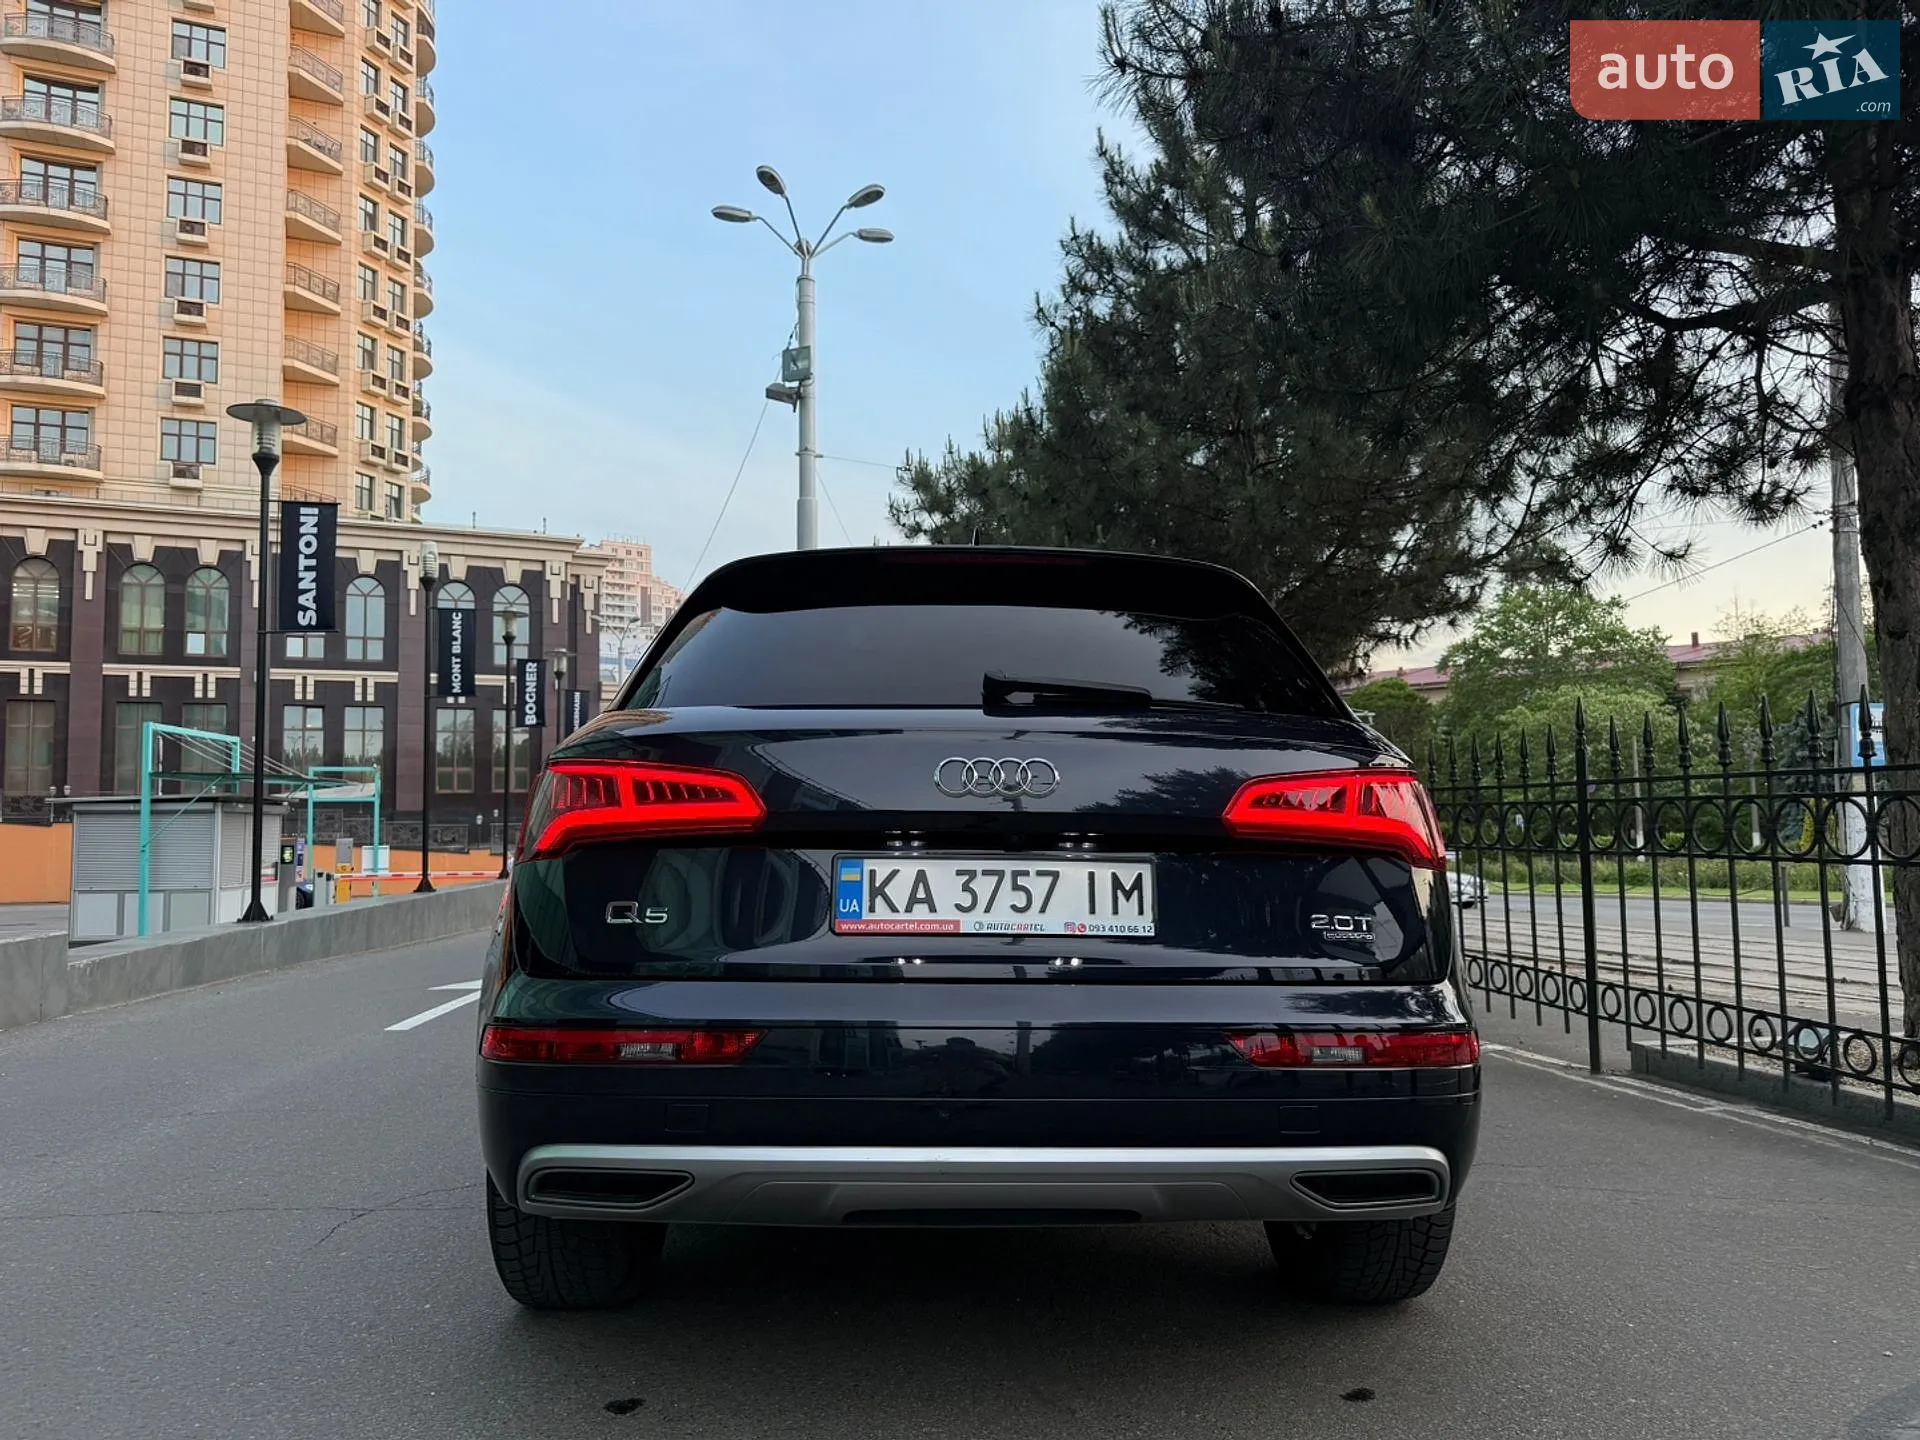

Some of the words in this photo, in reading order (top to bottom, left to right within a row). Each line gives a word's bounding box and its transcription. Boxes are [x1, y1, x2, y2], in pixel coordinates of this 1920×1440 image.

[297, 507, 319, 626] SANTONI
[452, 611, 462, 654] BLANC
[451, 656, 462, 693] MONT
[525, 662, 537, 725] BOGNER
[839, 898, 860, 912] UA
[868, 868, 937, 913] KA
[954, 869, 1060, 914] 3757
[1087, 870, 1144, 916] IM
[605, 901, 668, 924] Q5
[840, 920, 954, 931] www.autocartel.com.ua
[1142, 925, 1153, 933] 12
